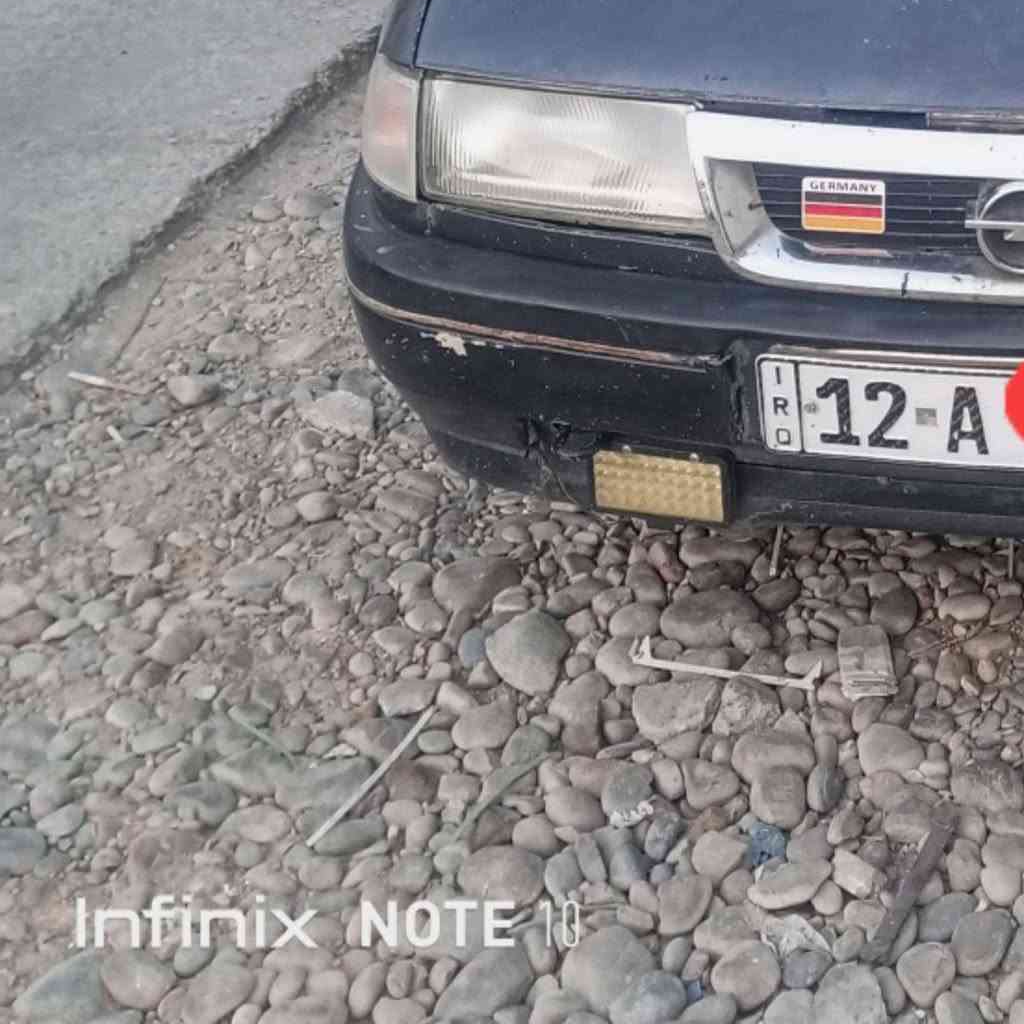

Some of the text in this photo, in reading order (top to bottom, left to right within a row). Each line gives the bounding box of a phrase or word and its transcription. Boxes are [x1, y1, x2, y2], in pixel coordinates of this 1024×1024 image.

[809, 180, 877, 193] GERMANY
[816, 377, 989, 456] 12 A
